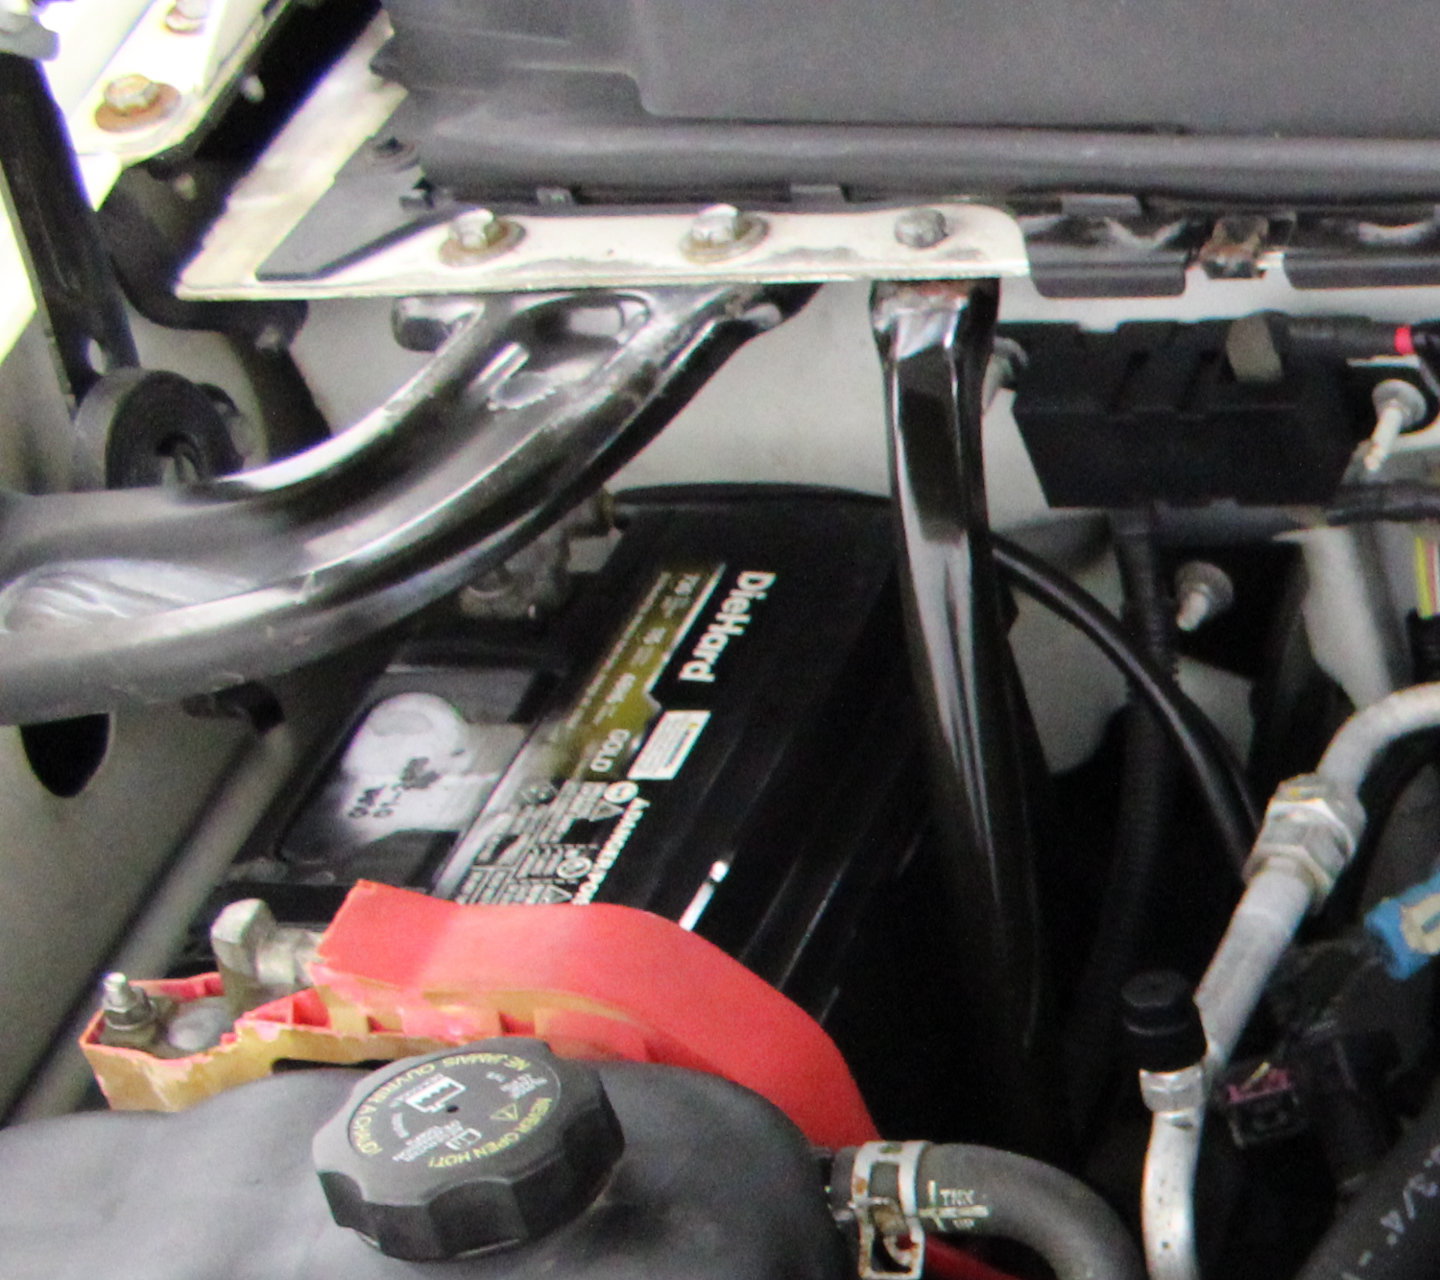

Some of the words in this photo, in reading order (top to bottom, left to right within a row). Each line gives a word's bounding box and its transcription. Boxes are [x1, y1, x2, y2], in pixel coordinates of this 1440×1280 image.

[679, 570, 777, 683] DieHard
[590, 728, 631, 773] GOLD
[428, 1151, 472, 1168] HOT!
[473, 1132, 520, 1159] OPEN
